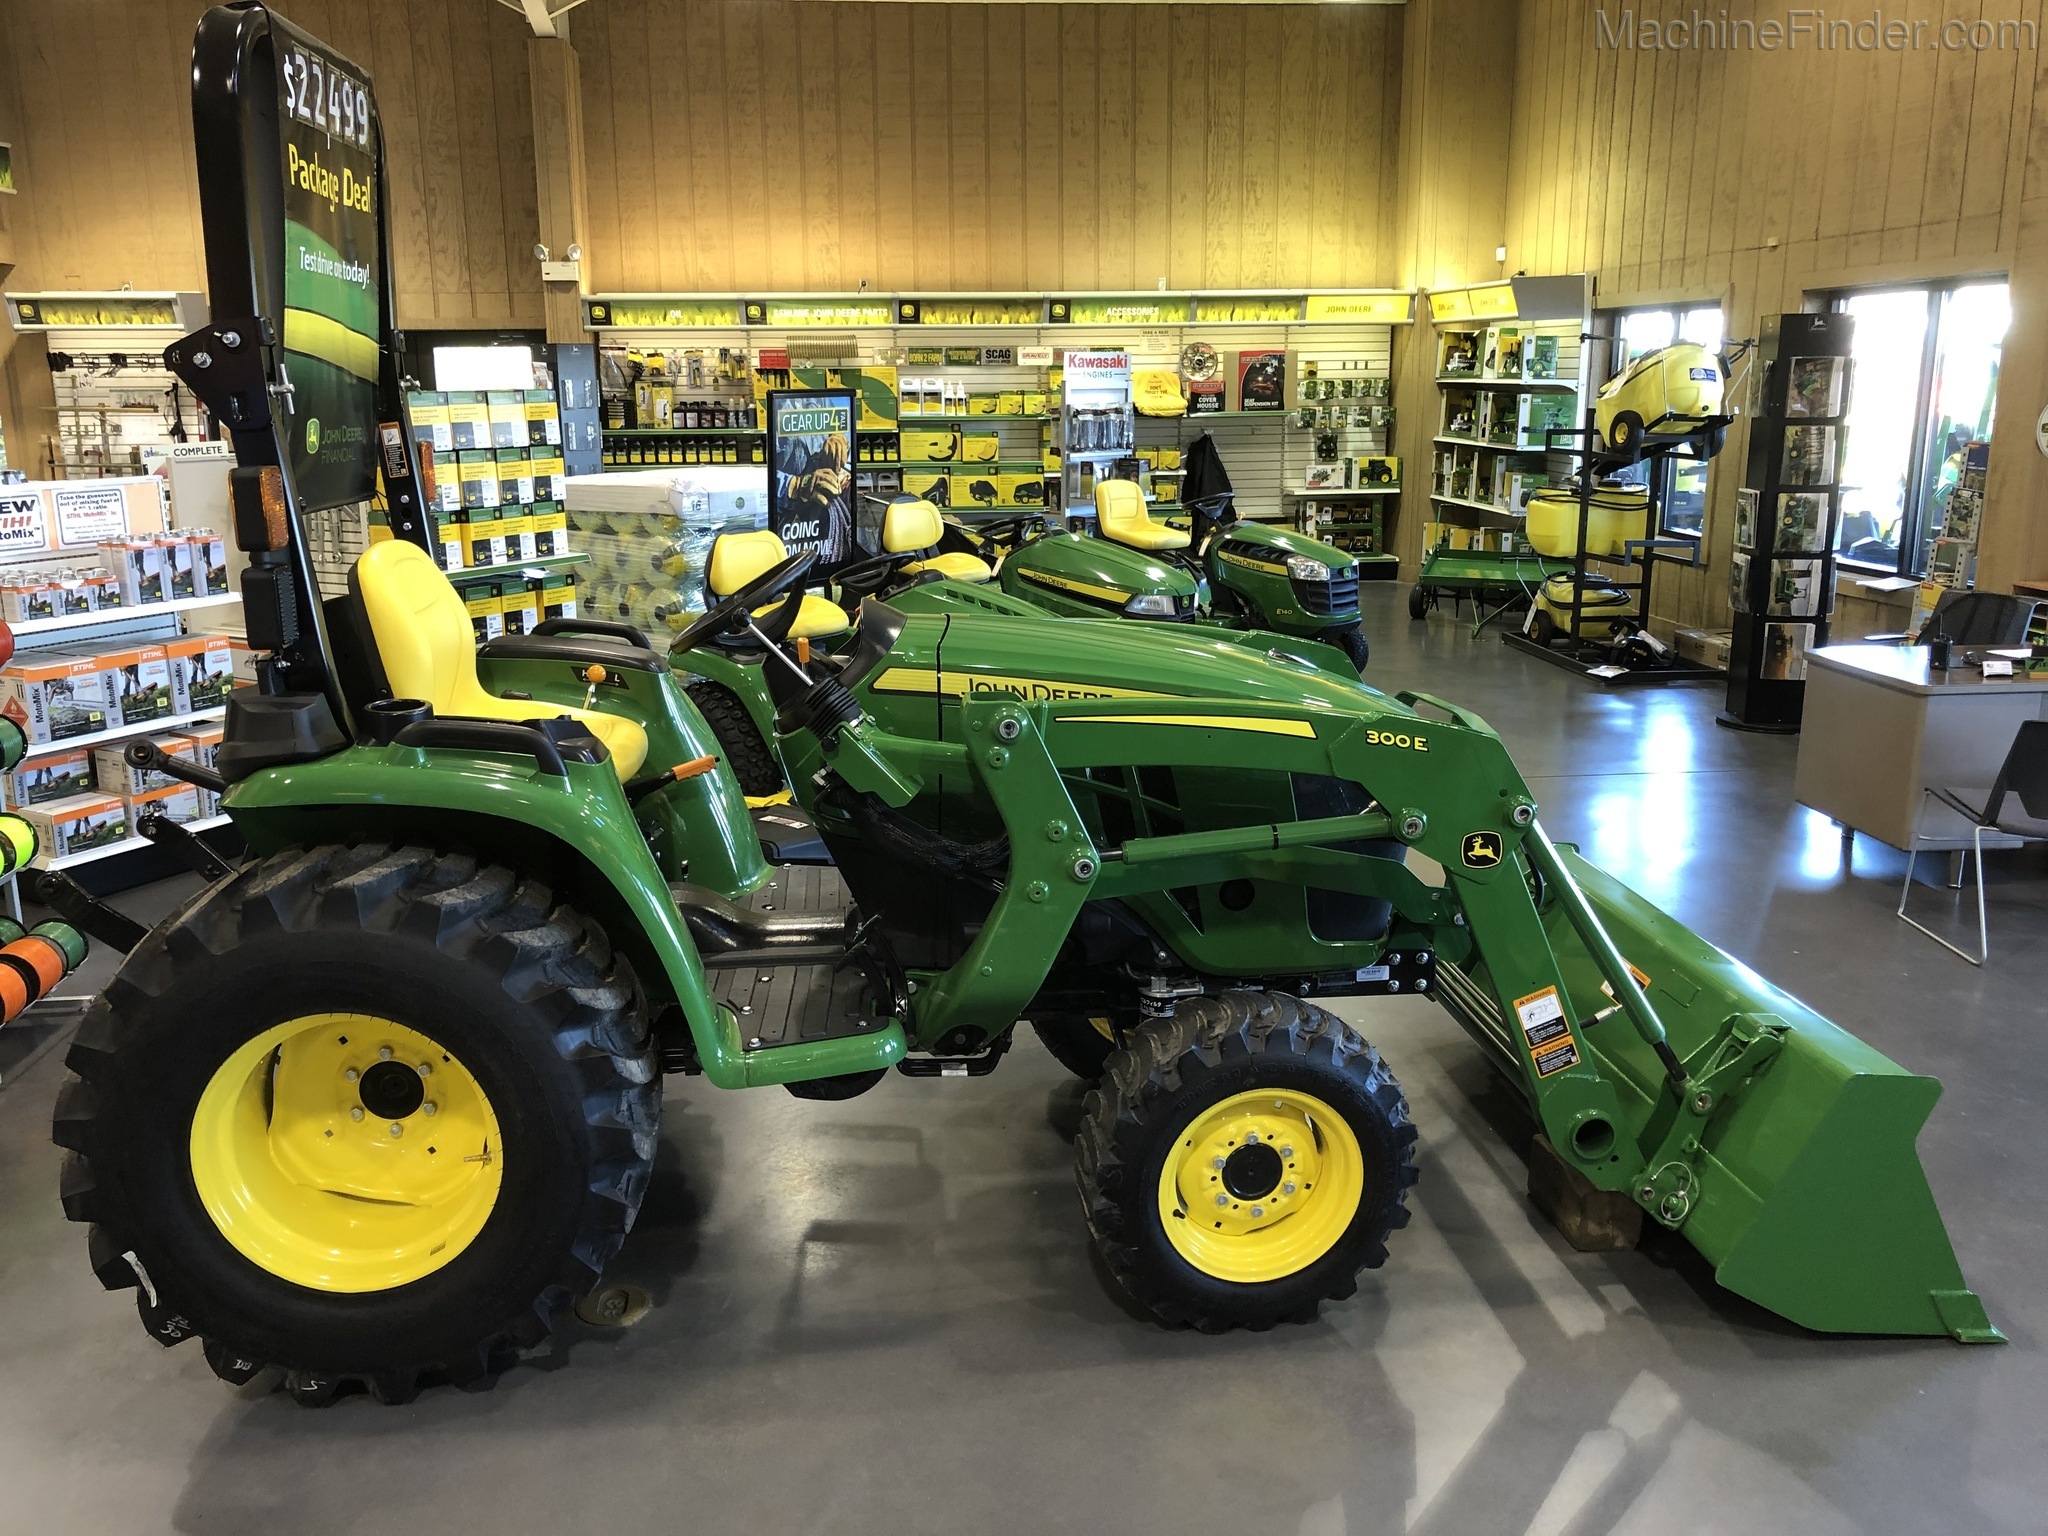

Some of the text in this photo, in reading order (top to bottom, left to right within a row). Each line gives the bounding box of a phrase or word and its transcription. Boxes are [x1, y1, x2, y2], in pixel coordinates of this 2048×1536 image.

[288, 143, 372, 214] Package Deal
[299, 245, 317, 272] Test
[317, 250, 334, 276] drive
[342, 260, 370, 290] today!
[669, 310, 684, 319] OIL
[772, 307, 889, 318] GENUINE JOHN DEERE PARTS
[1106, 306, 1160, 317] ACCESSORIES
[1325, 306, 1348, 314] JOHN
[1349, 305, 1373, 313] DEERE
[985, 349, 1011, 359] SCAG
[1067, 354, 1128, 369] Kawasaki
[1082, 371, 1113, 379] ENGINES
[782, 408, 841, 433] GEAR UP 4
[322, 425, 363, 445] JOHN DEERE
[173, 445, 223, 457] COMPLETE
[321, 448, 357, 464] FINANCIAL
[87, 492, 118, 500] guesswork
[782, 519, 820, 541] GOING
[1227, 554, 1266, 571] JOHN DEERE
[1031, 572, 1068, 589] JOHN DEERE
[208, 639, 228, 649] STIHL
[142, 650, 164, 660] STIHL
[73, 663, 96, 672] STIHL
[174, 662, 186, 696] MotoMix
[614, 674, 620, 682] L
[106, 674, 117, 709] MotoMix
[32, 687, 44, 723] MotoMix
[1525, 989, 1551, 1003] WARNING
[1543, 1039, 1569, 1053] WARNING
